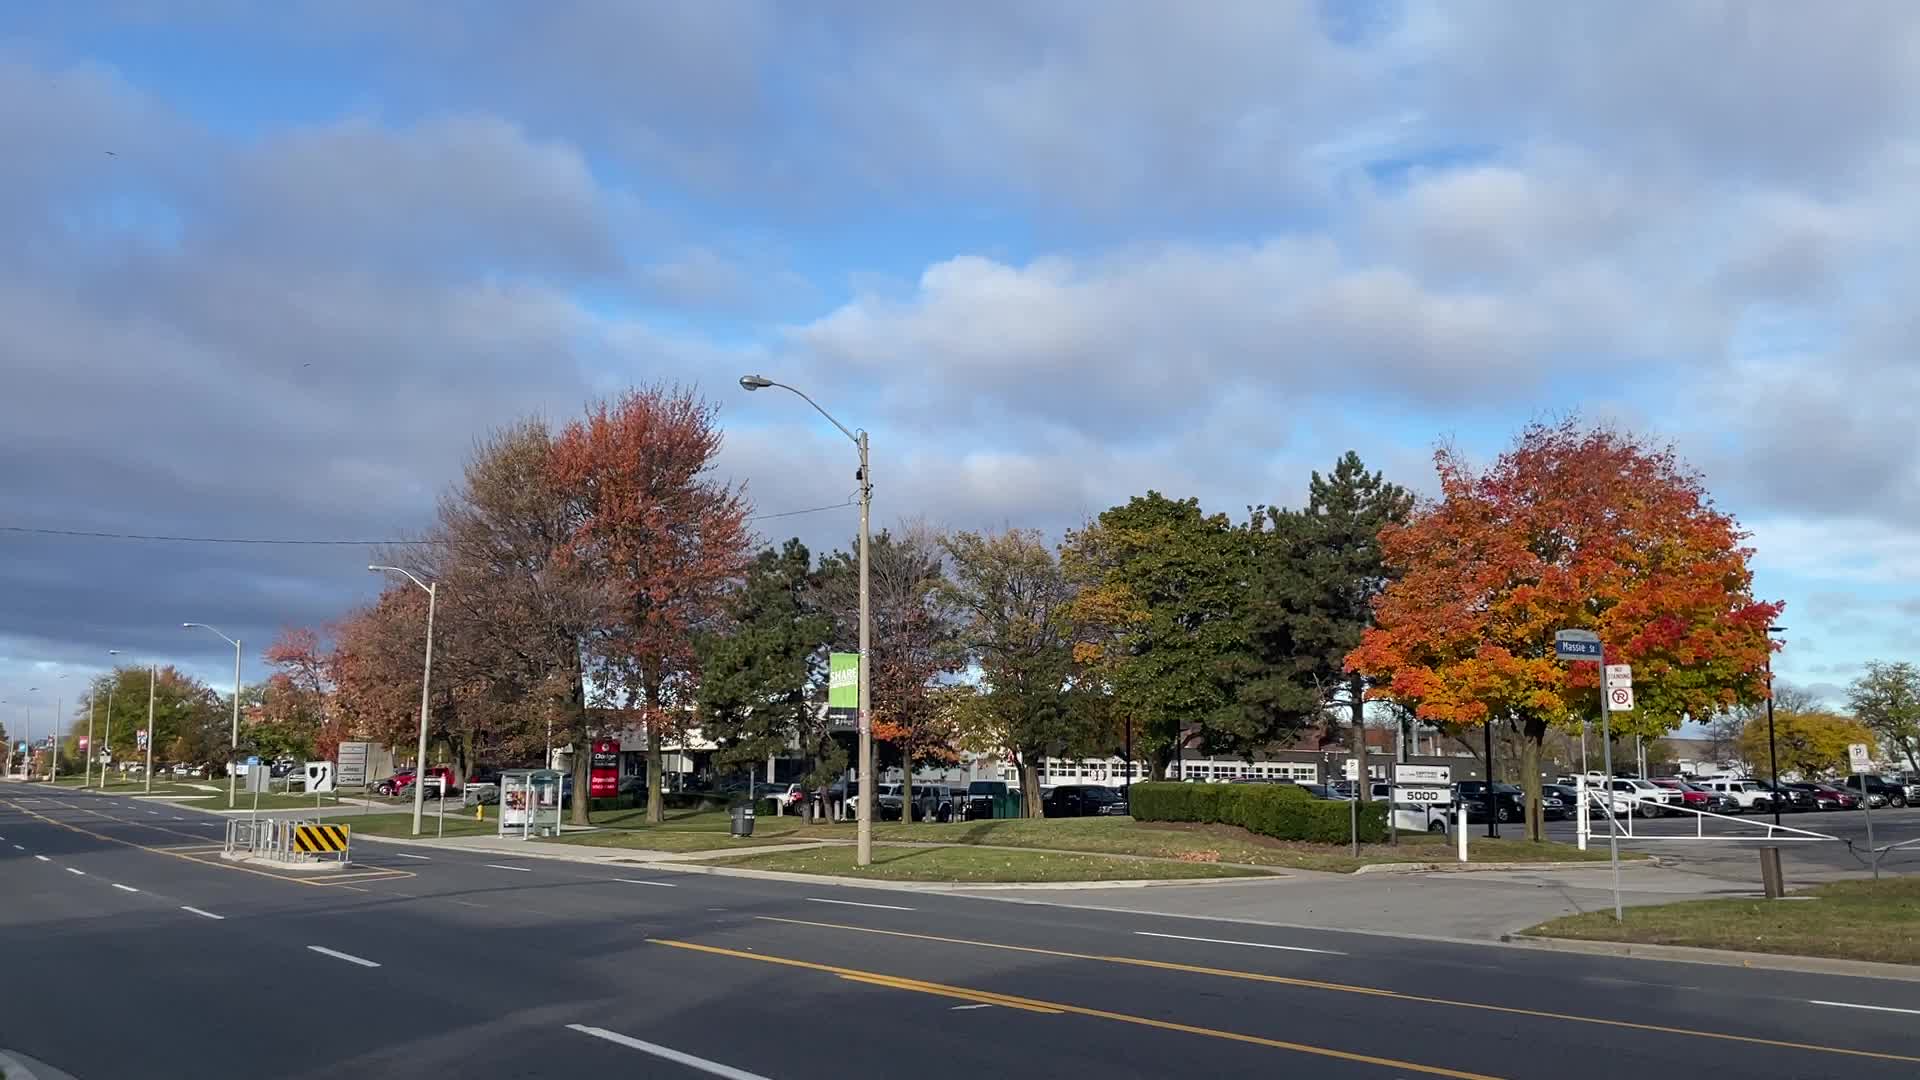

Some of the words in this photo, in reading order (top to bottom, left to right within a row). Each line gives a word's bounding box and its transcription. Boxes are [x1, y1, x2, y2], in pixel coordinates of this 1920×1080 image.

[1562, 641, 1586, 653] Massie
[1589, 645, 1595, 653] St
[830, 667, 857, 683] SHARE
[1407, 791, 1438, 801] 5000
